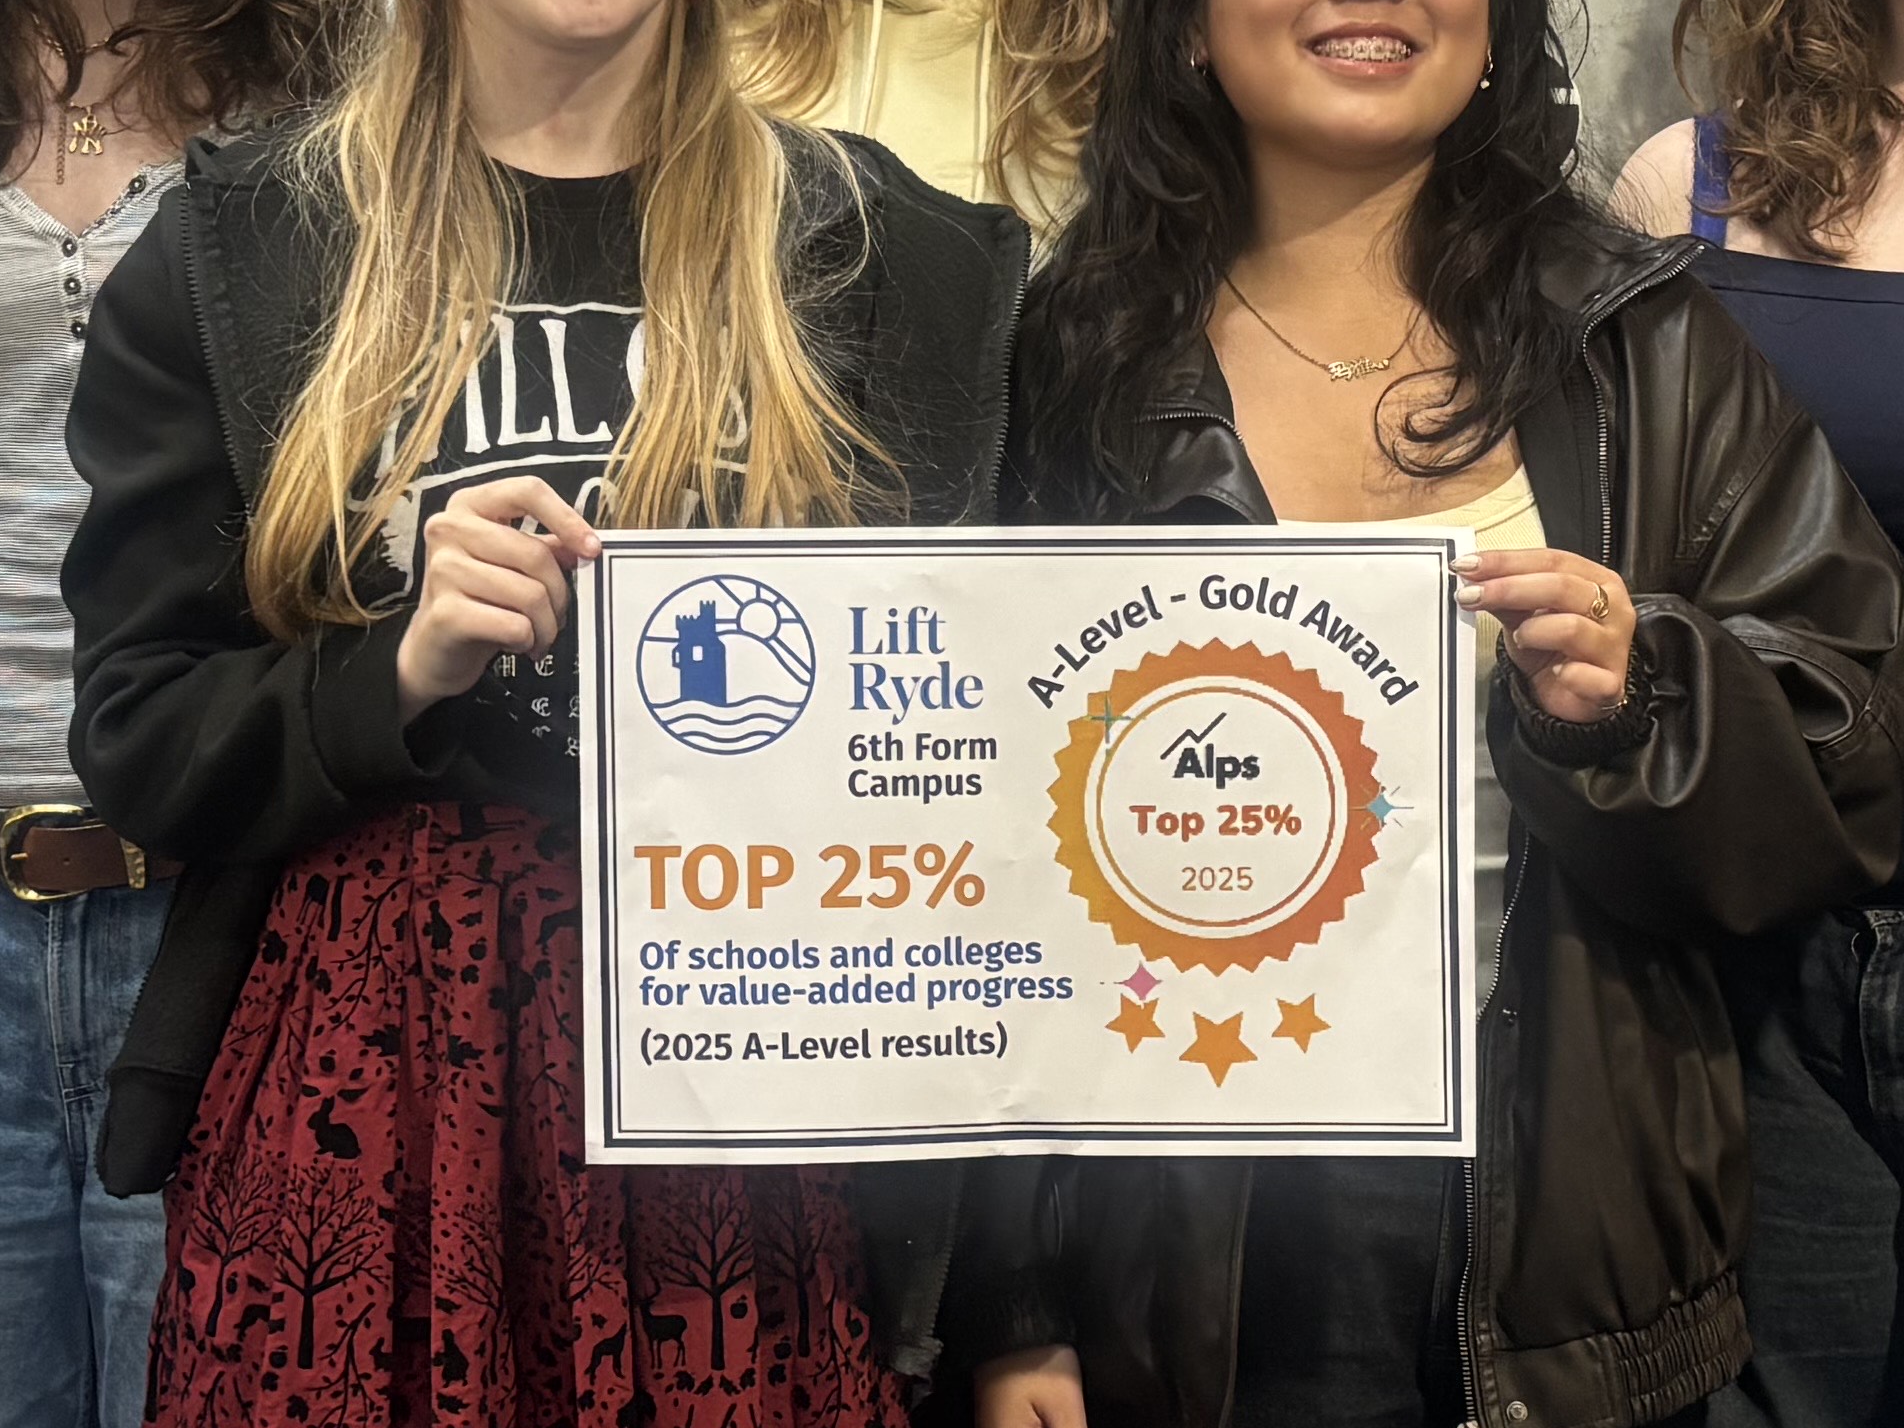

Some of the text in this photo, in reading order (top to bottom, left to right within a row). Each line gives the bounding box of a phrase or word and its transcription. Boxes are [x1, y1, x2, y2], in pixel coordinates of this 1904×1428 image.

[848, 604, 947, 656] Lift
[1026, 583, 1165, 712] A-Level
[1198, 572, 1293, 621] Gold
[1302, 597, 1421, 708] Award
[848, 661, 985, 725] Ryde
[847, 731, 998, 763] 6th Form
[1173, 747, 1261, 790] Alps
[847, 767, 983, 803] Campus
[1128, 803, 1303, 842] Top 25%
[633, 839, 986, 912] TOP 25%
[1179, 865, 1255, 894] 2025
[638, 934, 1043, 978] Of schools and colleges
[638, 972, 1075, 1012] for value-added progress
[638, 1021, 1010, 1067] (2025 A-Level results)
